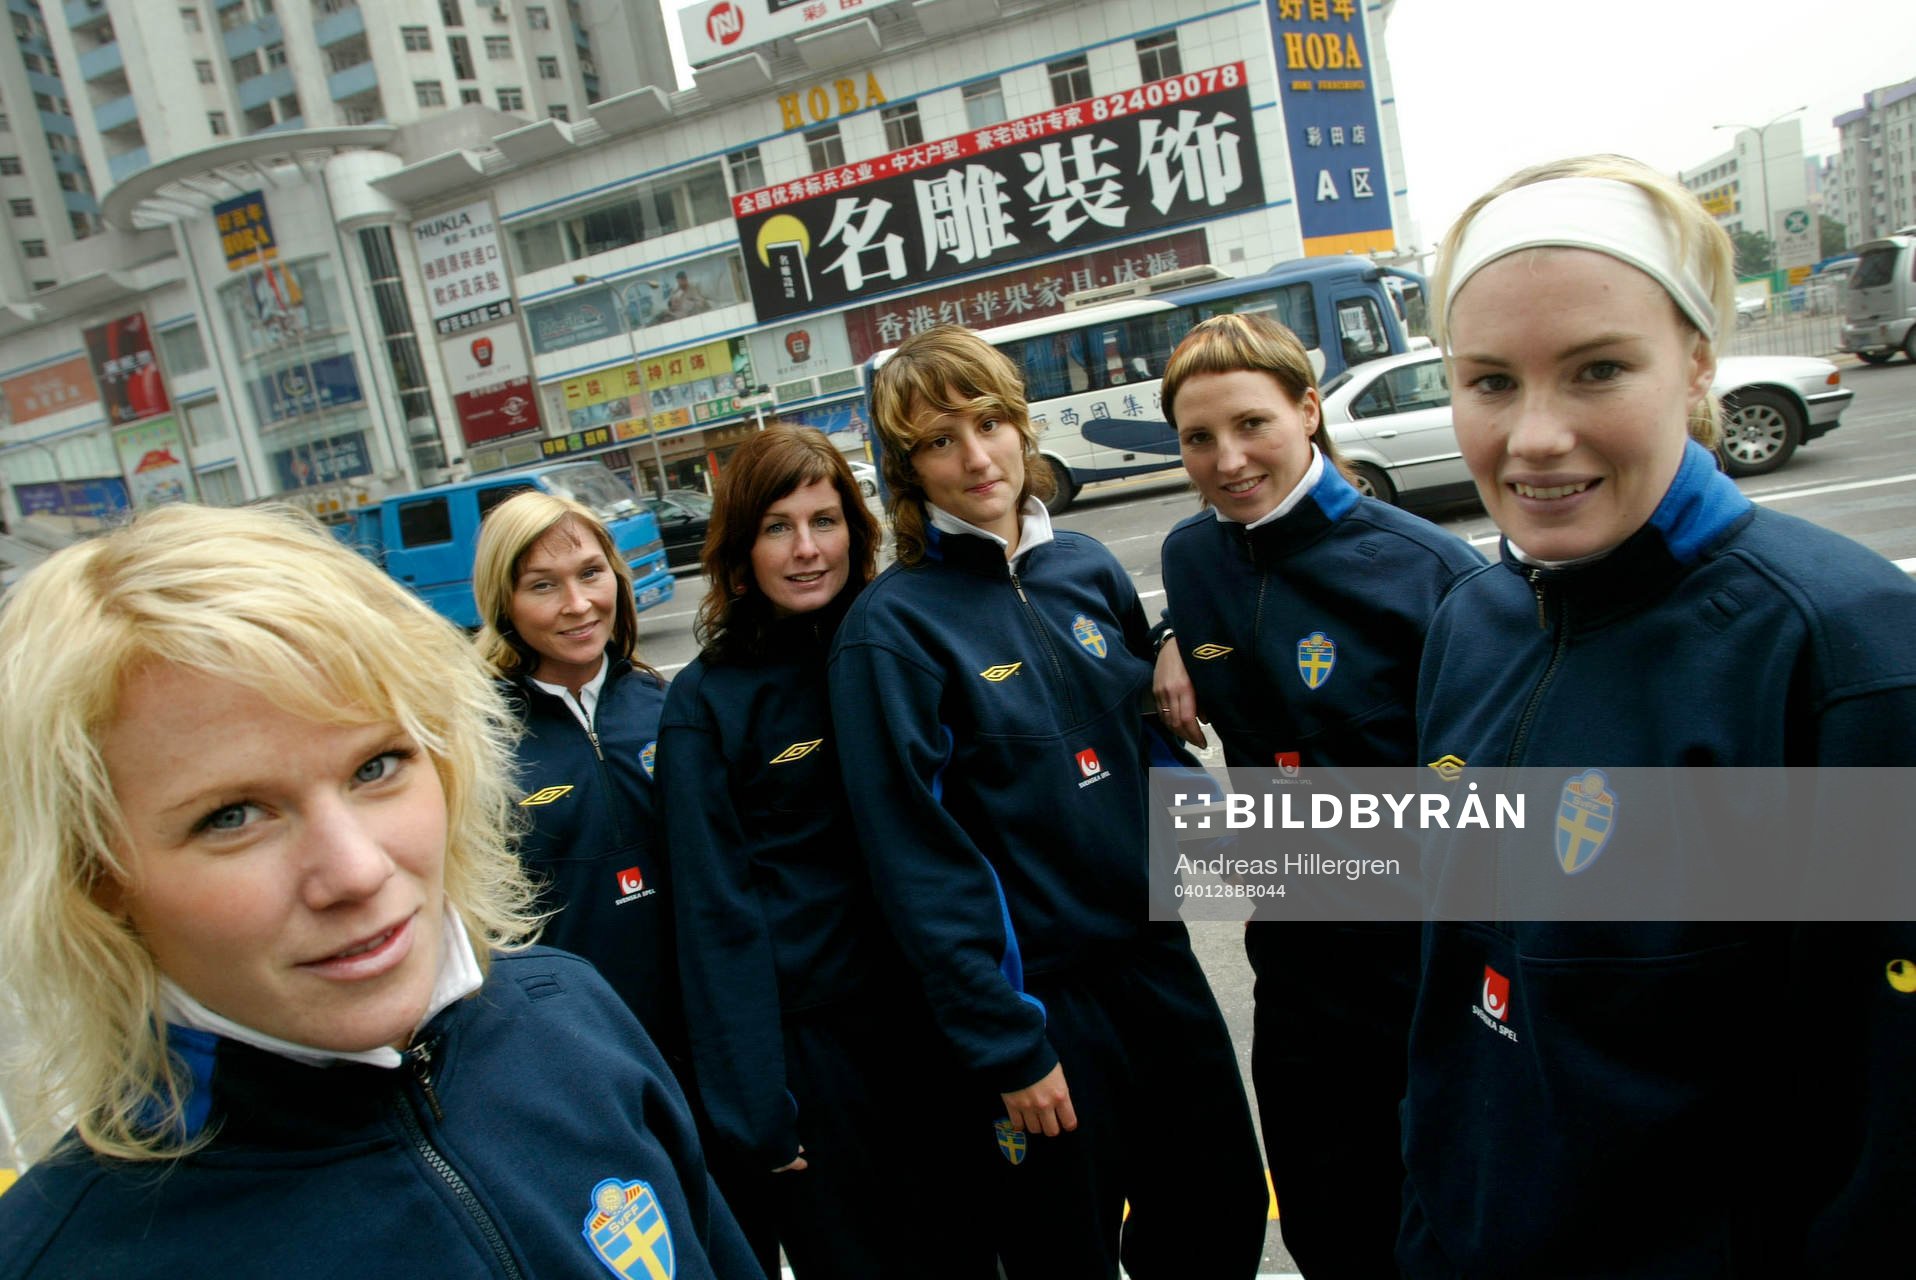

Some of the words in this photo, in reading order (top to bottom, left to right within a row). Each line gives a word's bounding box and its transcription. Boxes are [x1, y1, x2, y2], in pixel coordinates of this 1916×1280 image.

[1283, 32, 1363, 70] HOBA
[777, 71, 888, 131] HOBA
[1091, 64, 1239, 121] 82409078
[818, 109, 1244, 292] 名雕装饰
[416, 212, 472, 240] HUKLA
[1498, 1024, 1519, 1042] SPEL
